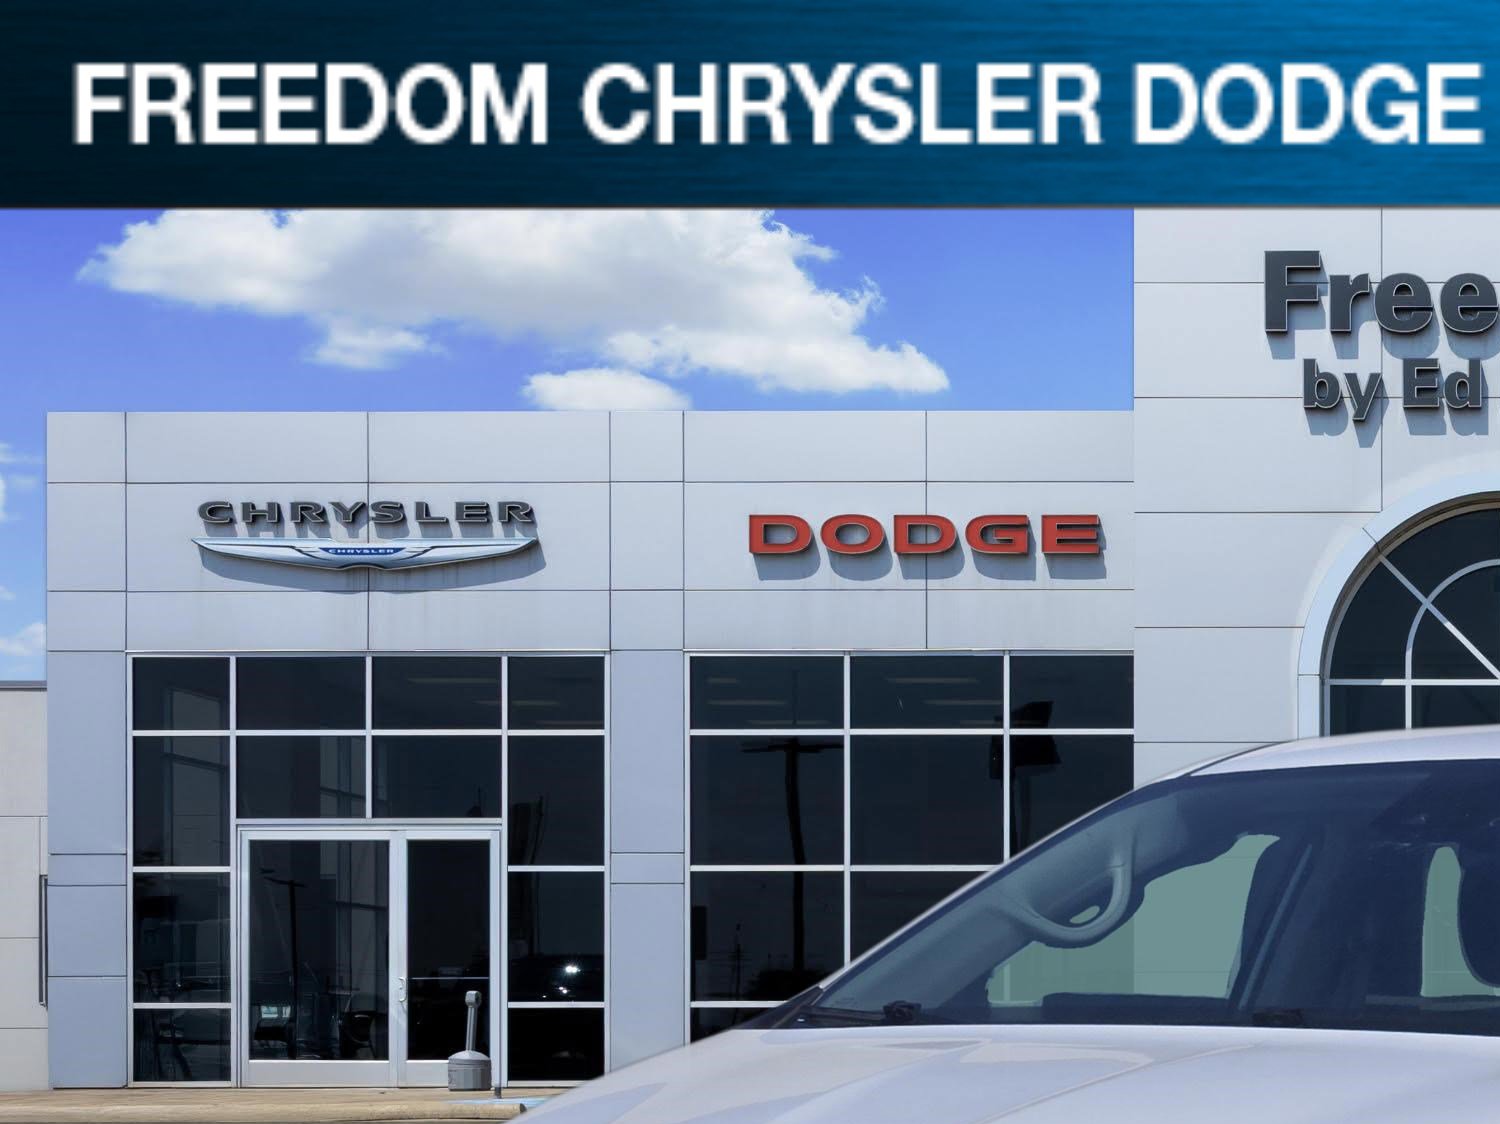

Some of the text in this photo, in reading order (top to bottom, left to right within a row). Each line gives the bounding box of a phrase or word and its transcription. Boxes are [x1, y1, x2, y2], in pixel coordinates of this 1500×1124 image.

[1303, 358, 1382, 421] by
[1402, 357, 1482, 408] Ed
[197, 500, 534, 524] CHRYSLER
[748, 514, 1100, 555] DODGE
[327, 547, 395, 555] CHRYSLER
